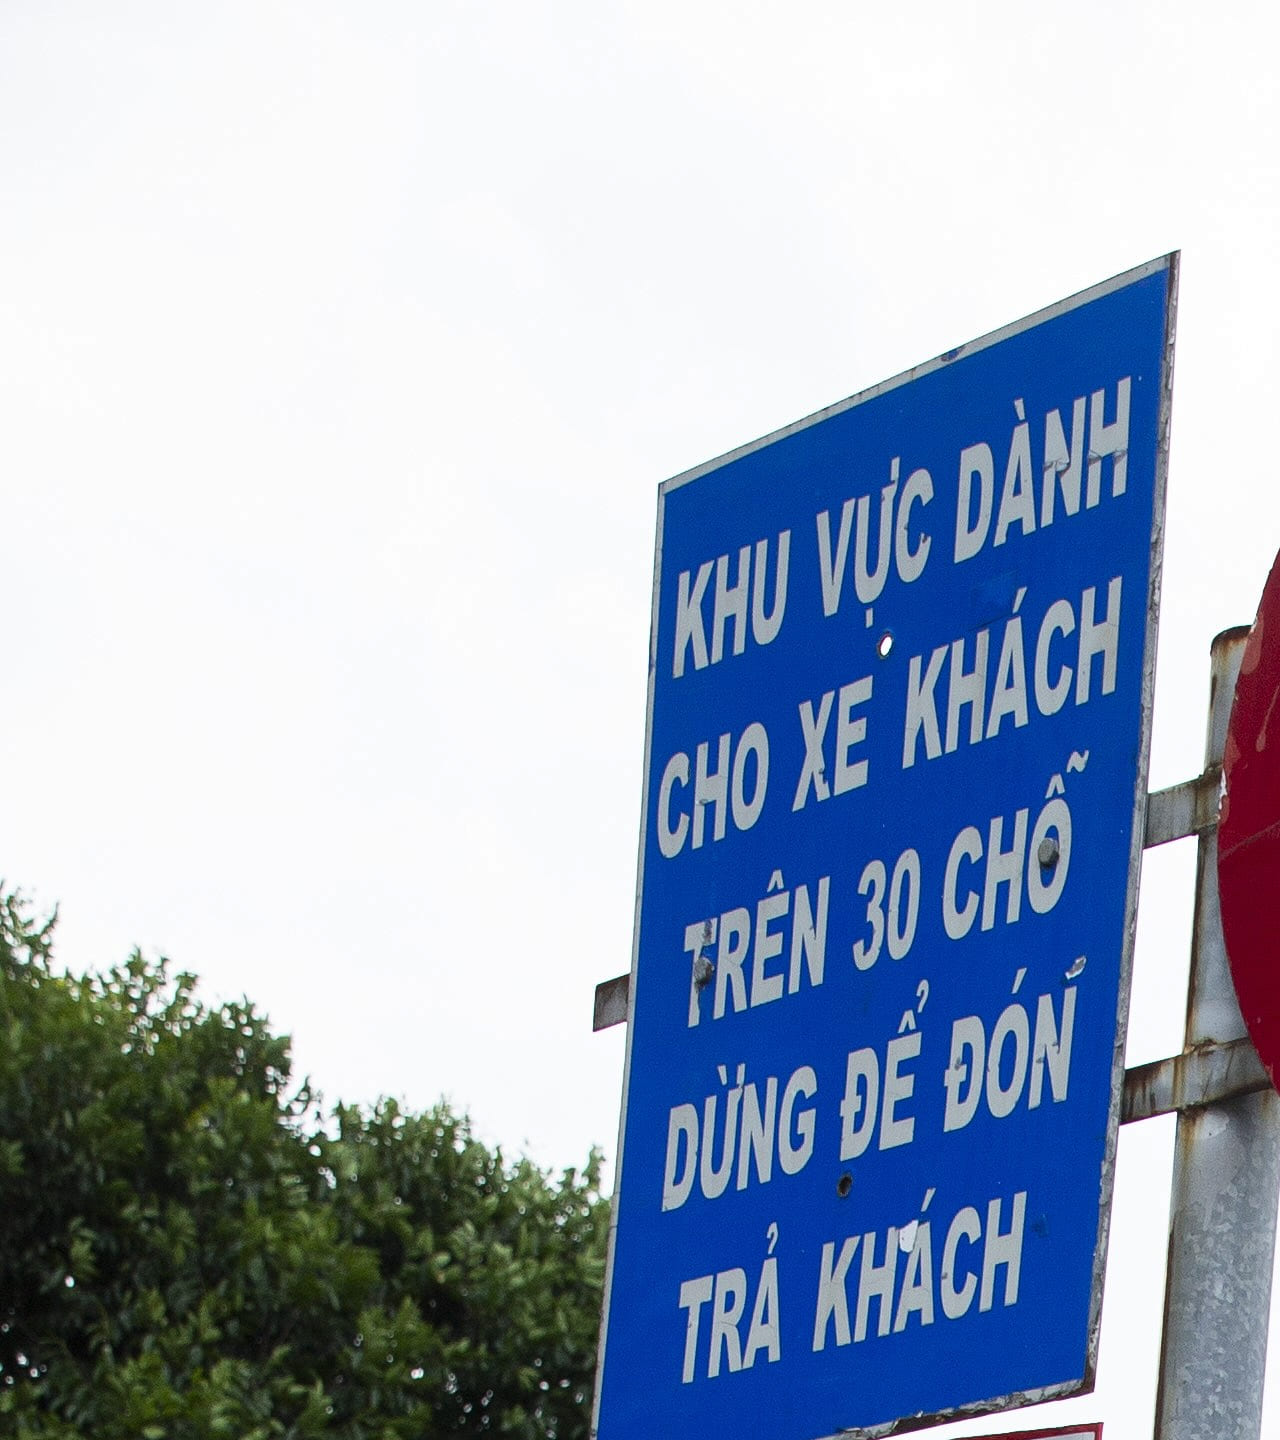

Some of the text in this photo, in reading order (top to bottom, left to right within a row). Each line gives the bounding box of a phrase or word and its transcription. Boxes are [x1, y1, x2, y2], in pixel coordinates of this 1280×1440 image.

[673, 376, 1131, 680] KHU VỰC DÀNH
[657, 576, 1123, 859] CHO XE KHÁCH
[684, 749, 1091, 1029] TRÊN 30 CHỖ
[662, 968, 1079, 1212] DỪNG ĐỂ ĐÓN
[679, 1189, 1029, 1385] TRẢ KHÁCH
